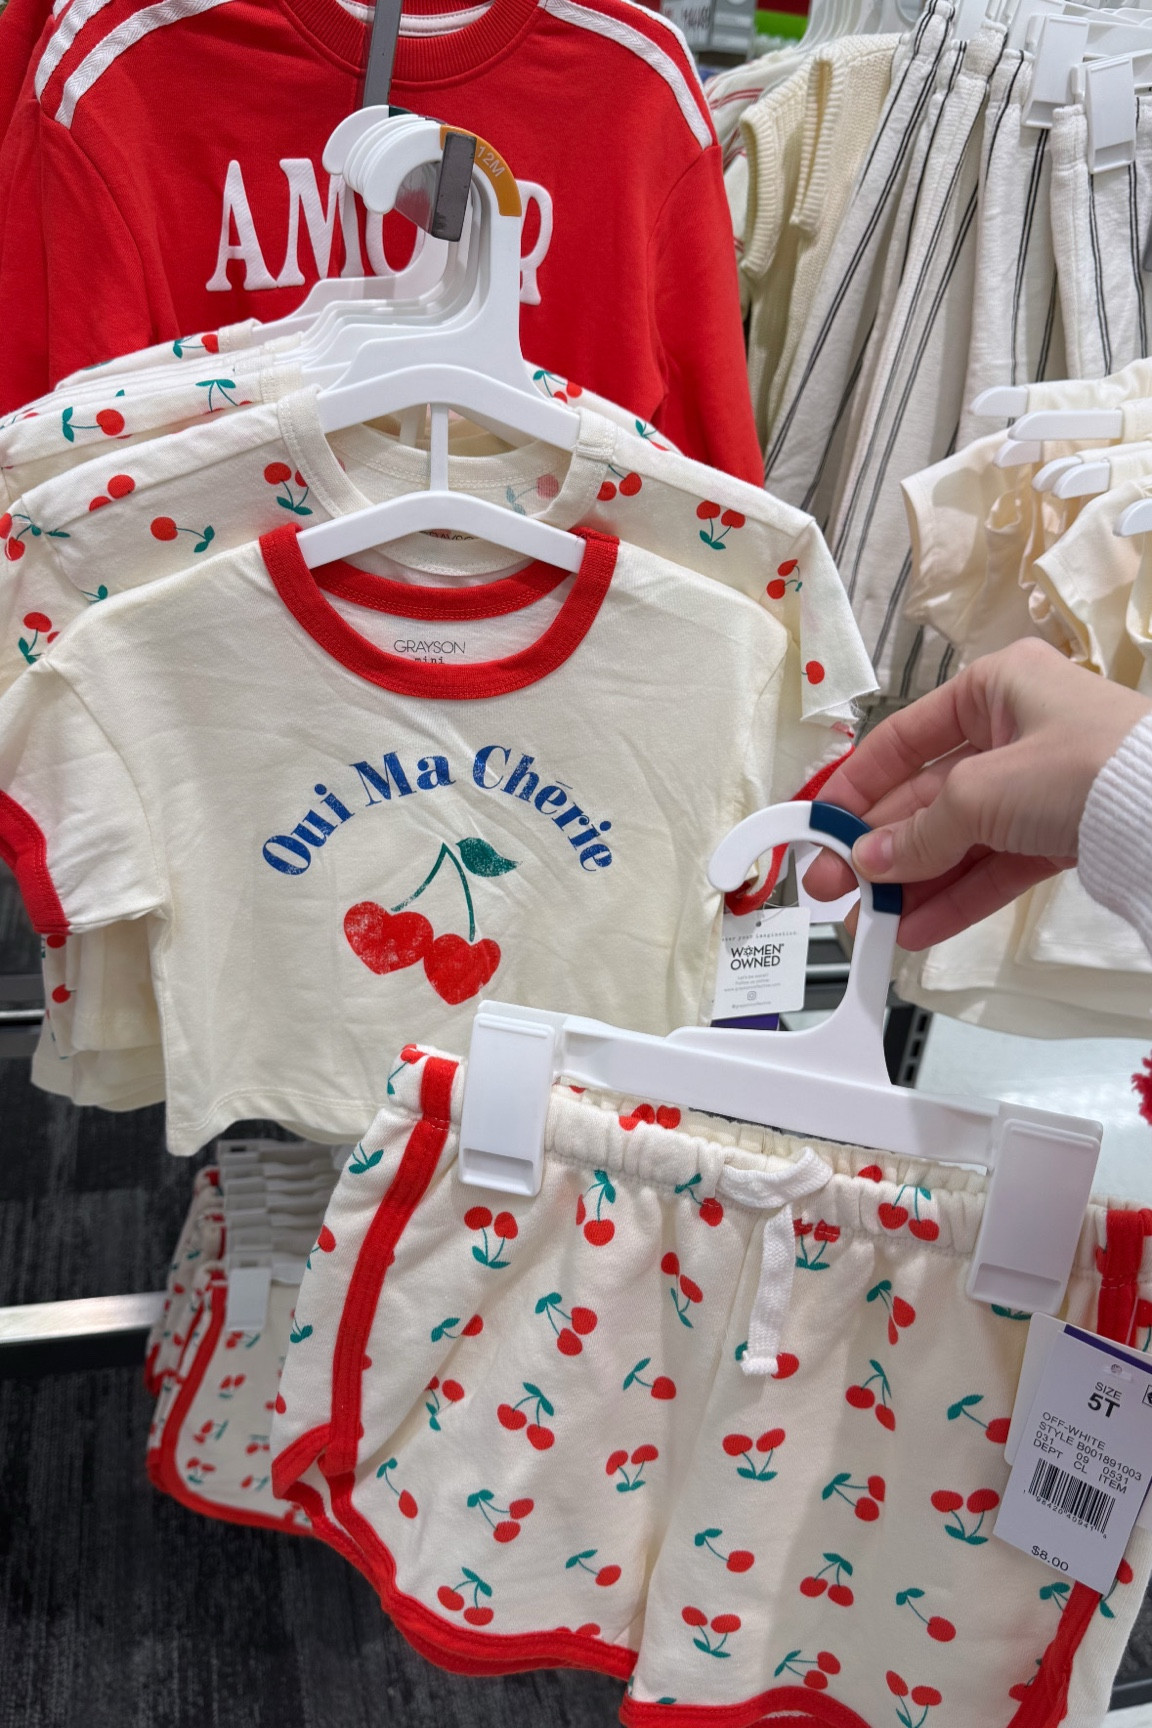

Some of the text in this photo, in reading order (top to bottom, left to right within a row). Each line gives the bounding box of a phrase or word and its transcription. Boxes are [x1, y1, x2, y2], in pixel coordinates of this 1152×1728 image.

[477, 146, 506, 177] 12M
[393, 639, 466, 654] GRAYSON
[262, 783, 355, 875] Oui
[349, 751, 456, 807] Ma
[730, 955, 781, 970] OWNED
[731, 943, 782, 958] WOMEN
[1087, 1392, 1120, 1418] 5T
[1095, 1381, 1122, 1400] SIZE
[1042, 1411, 1106, 1450] OFF-WHITE
[1036, 1430, 1129, 1485] 031 09 0531
[1039, 1421, 1142, 1481] STYLE B001891003
[1033, 1438, 1128, 1494] DEPT CL ITEM
[1031, 1545, 1069, 1572] $8.00
